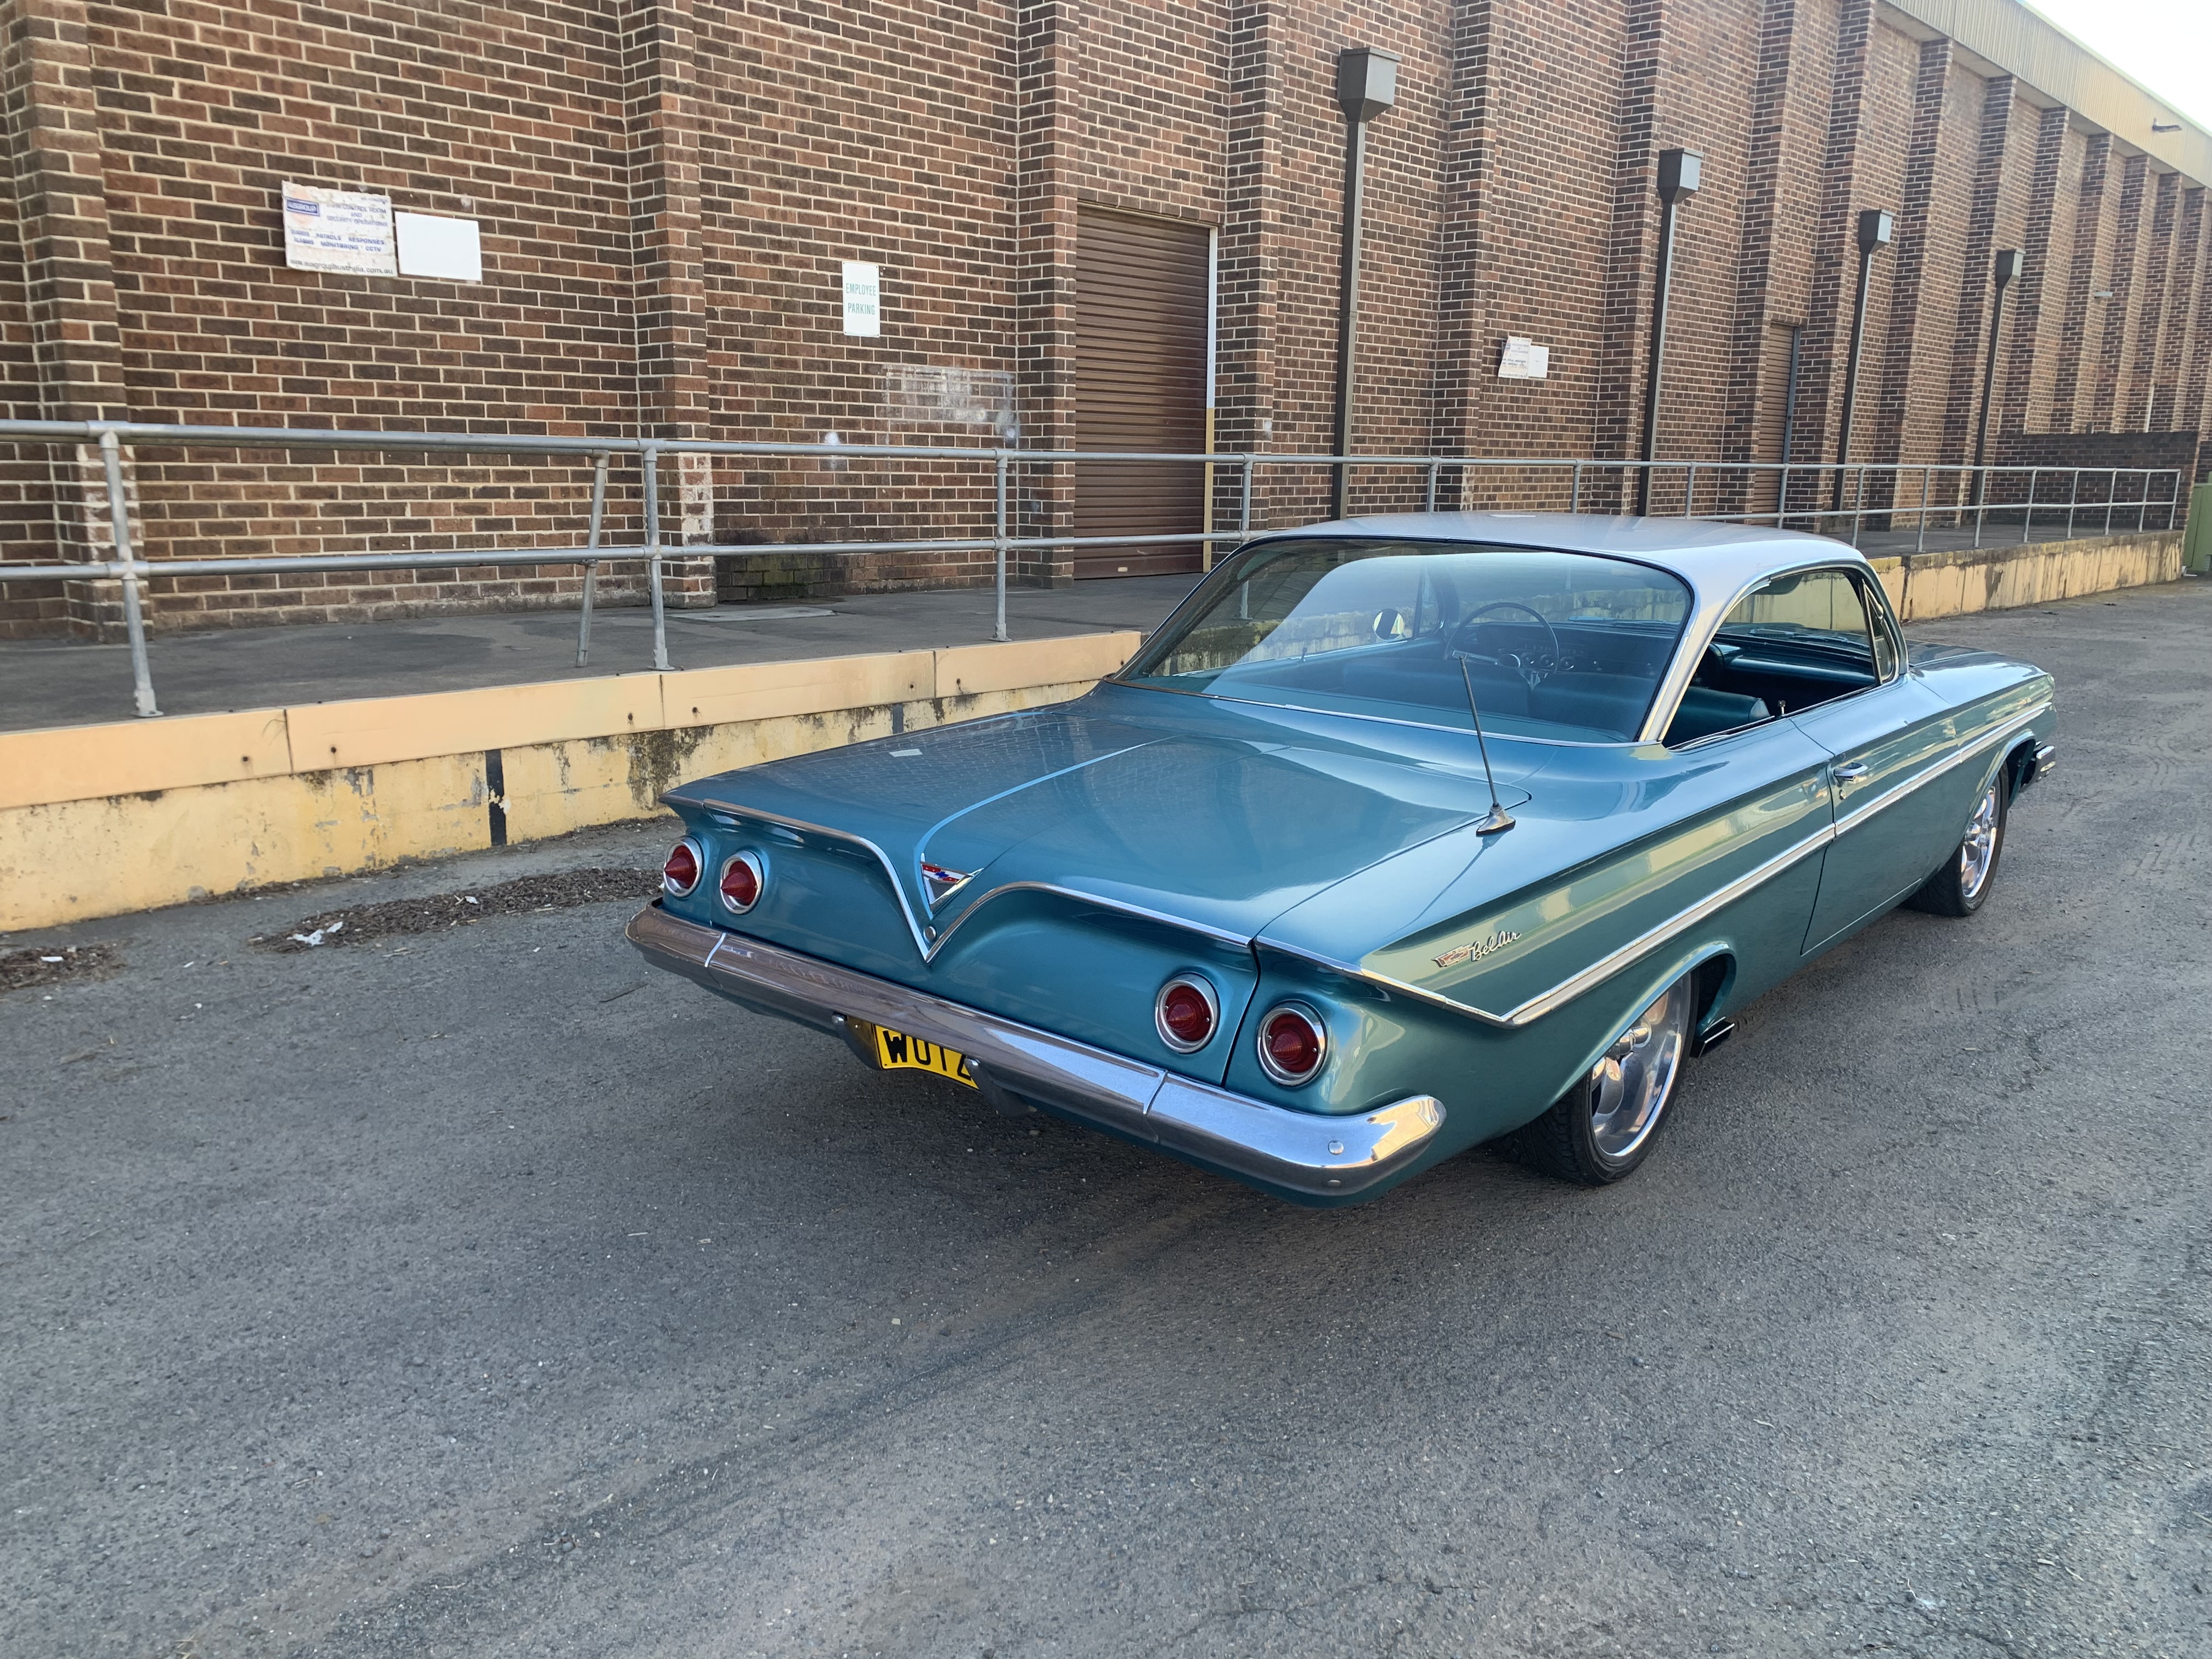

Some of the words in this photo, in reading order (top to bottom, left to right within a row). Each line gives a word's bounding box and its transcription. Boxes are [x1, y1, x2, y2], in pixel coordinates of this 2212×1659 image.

[326, 215, 352, 223] SECURITY
[353, 218, 388, 227] OPERATIONS
[294, 236, 314, 245] ALARMS
[320, 240, 359, 250] MONITORING
[315, 233, 341, 241] PATROLS
[348, 236, 385, 245] RESPONSES
[846, 283, 876, 296] EMPLOYEE
[848, 303, 876, 315] PARKING
